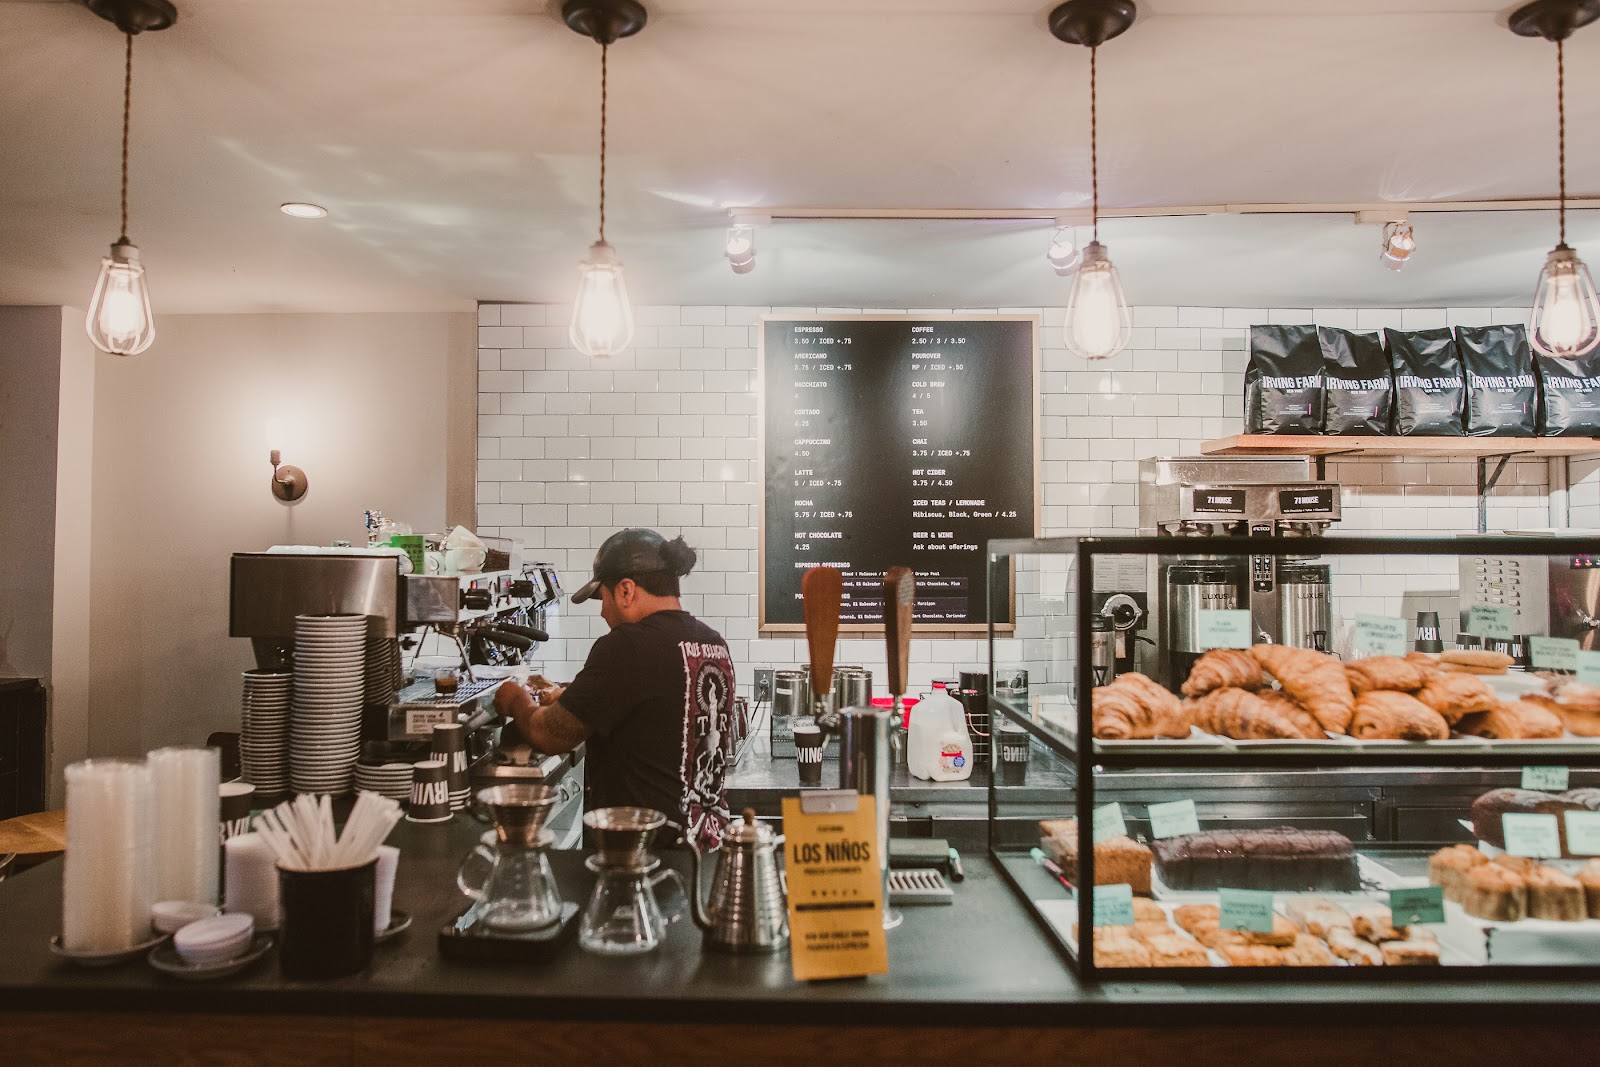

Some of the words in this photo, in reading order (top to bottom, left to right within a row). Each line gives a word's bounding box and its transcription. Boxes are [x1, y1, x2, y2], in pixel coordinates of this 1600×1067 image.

[1262, 376, 1296, 388] IRVING
[1296, 375, 1321, 388] FARM
[1326, 377, 1360, 390] IRVING
[1360, 378, 1390, 390] FARM
[1400, 376, 1433, 388] IRVING
[1432, 376, 1462, 388] FARM
[1472, 376, 1506, 388] IRVING
[1506, 374, 1534, 388] FARM
[1546, 376, 1584, 389] IRVING
[1215, 496, 1233, 504] HOUSE
[697, 715, 708, 736] T
[719, 713, 727, 732] R
[793, 844, 821, 864] LOS
[825, 838, 870, 862] NIÑOS
